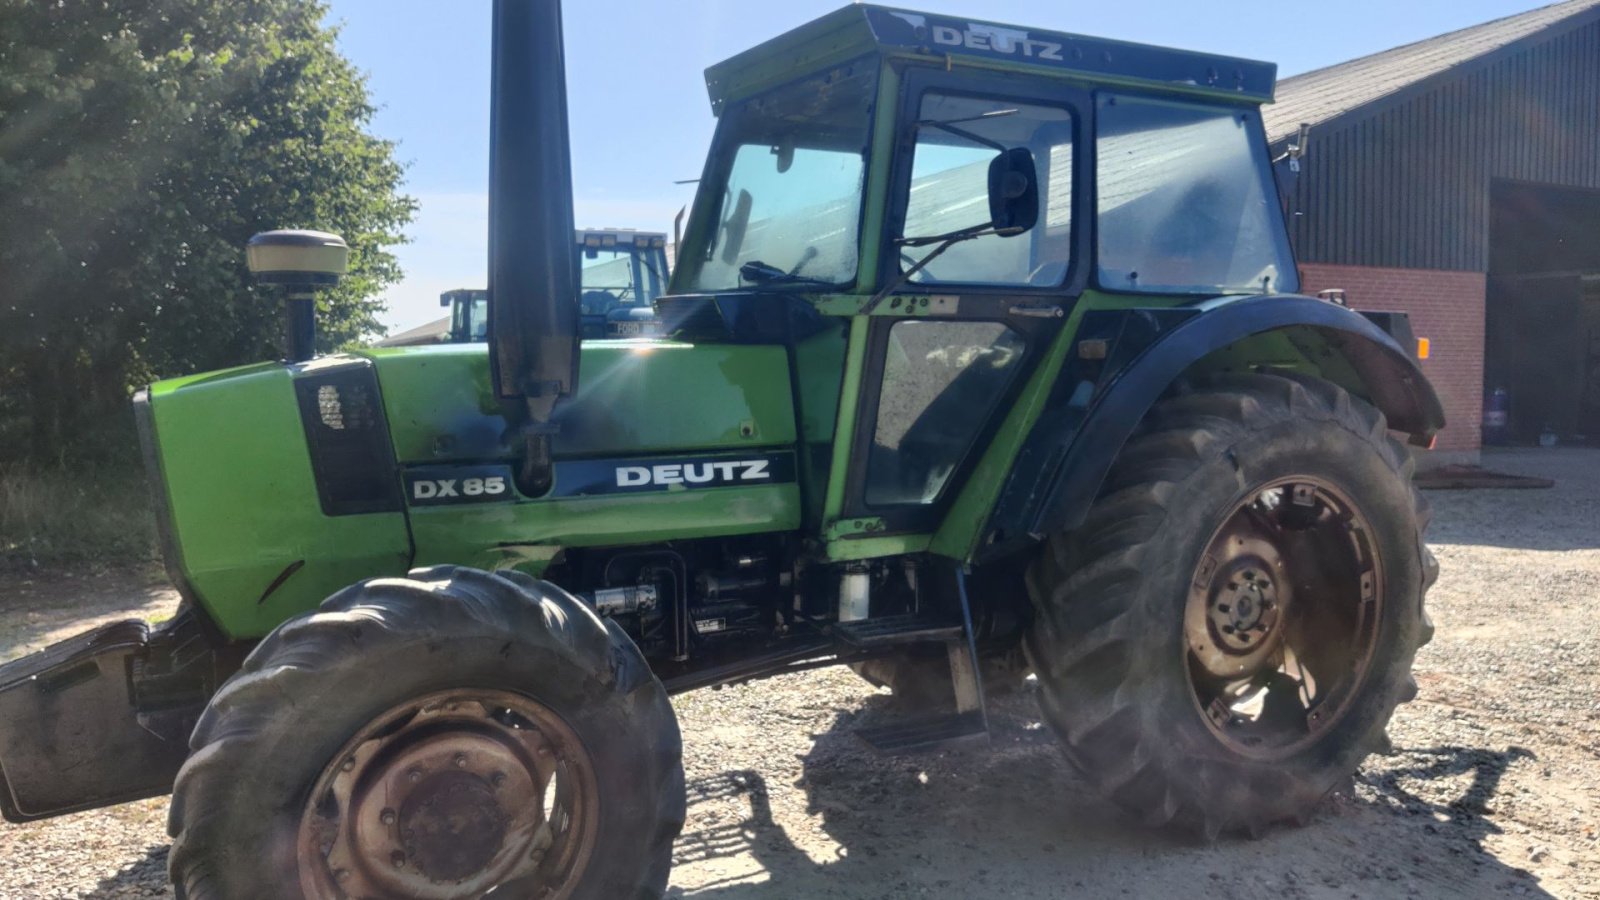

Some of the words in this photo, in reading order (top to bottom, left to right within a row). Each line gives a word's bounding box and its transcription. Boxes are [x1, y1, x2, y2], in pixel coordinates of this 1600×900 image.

[932, 25, 1063, 60] DEUTZ
[617, 322, 640, 334] FORD
[616, 460, 770, 487] DEUTZ
[414, 479, 459, 499] DX
[463, 476, 505, 495] 85
